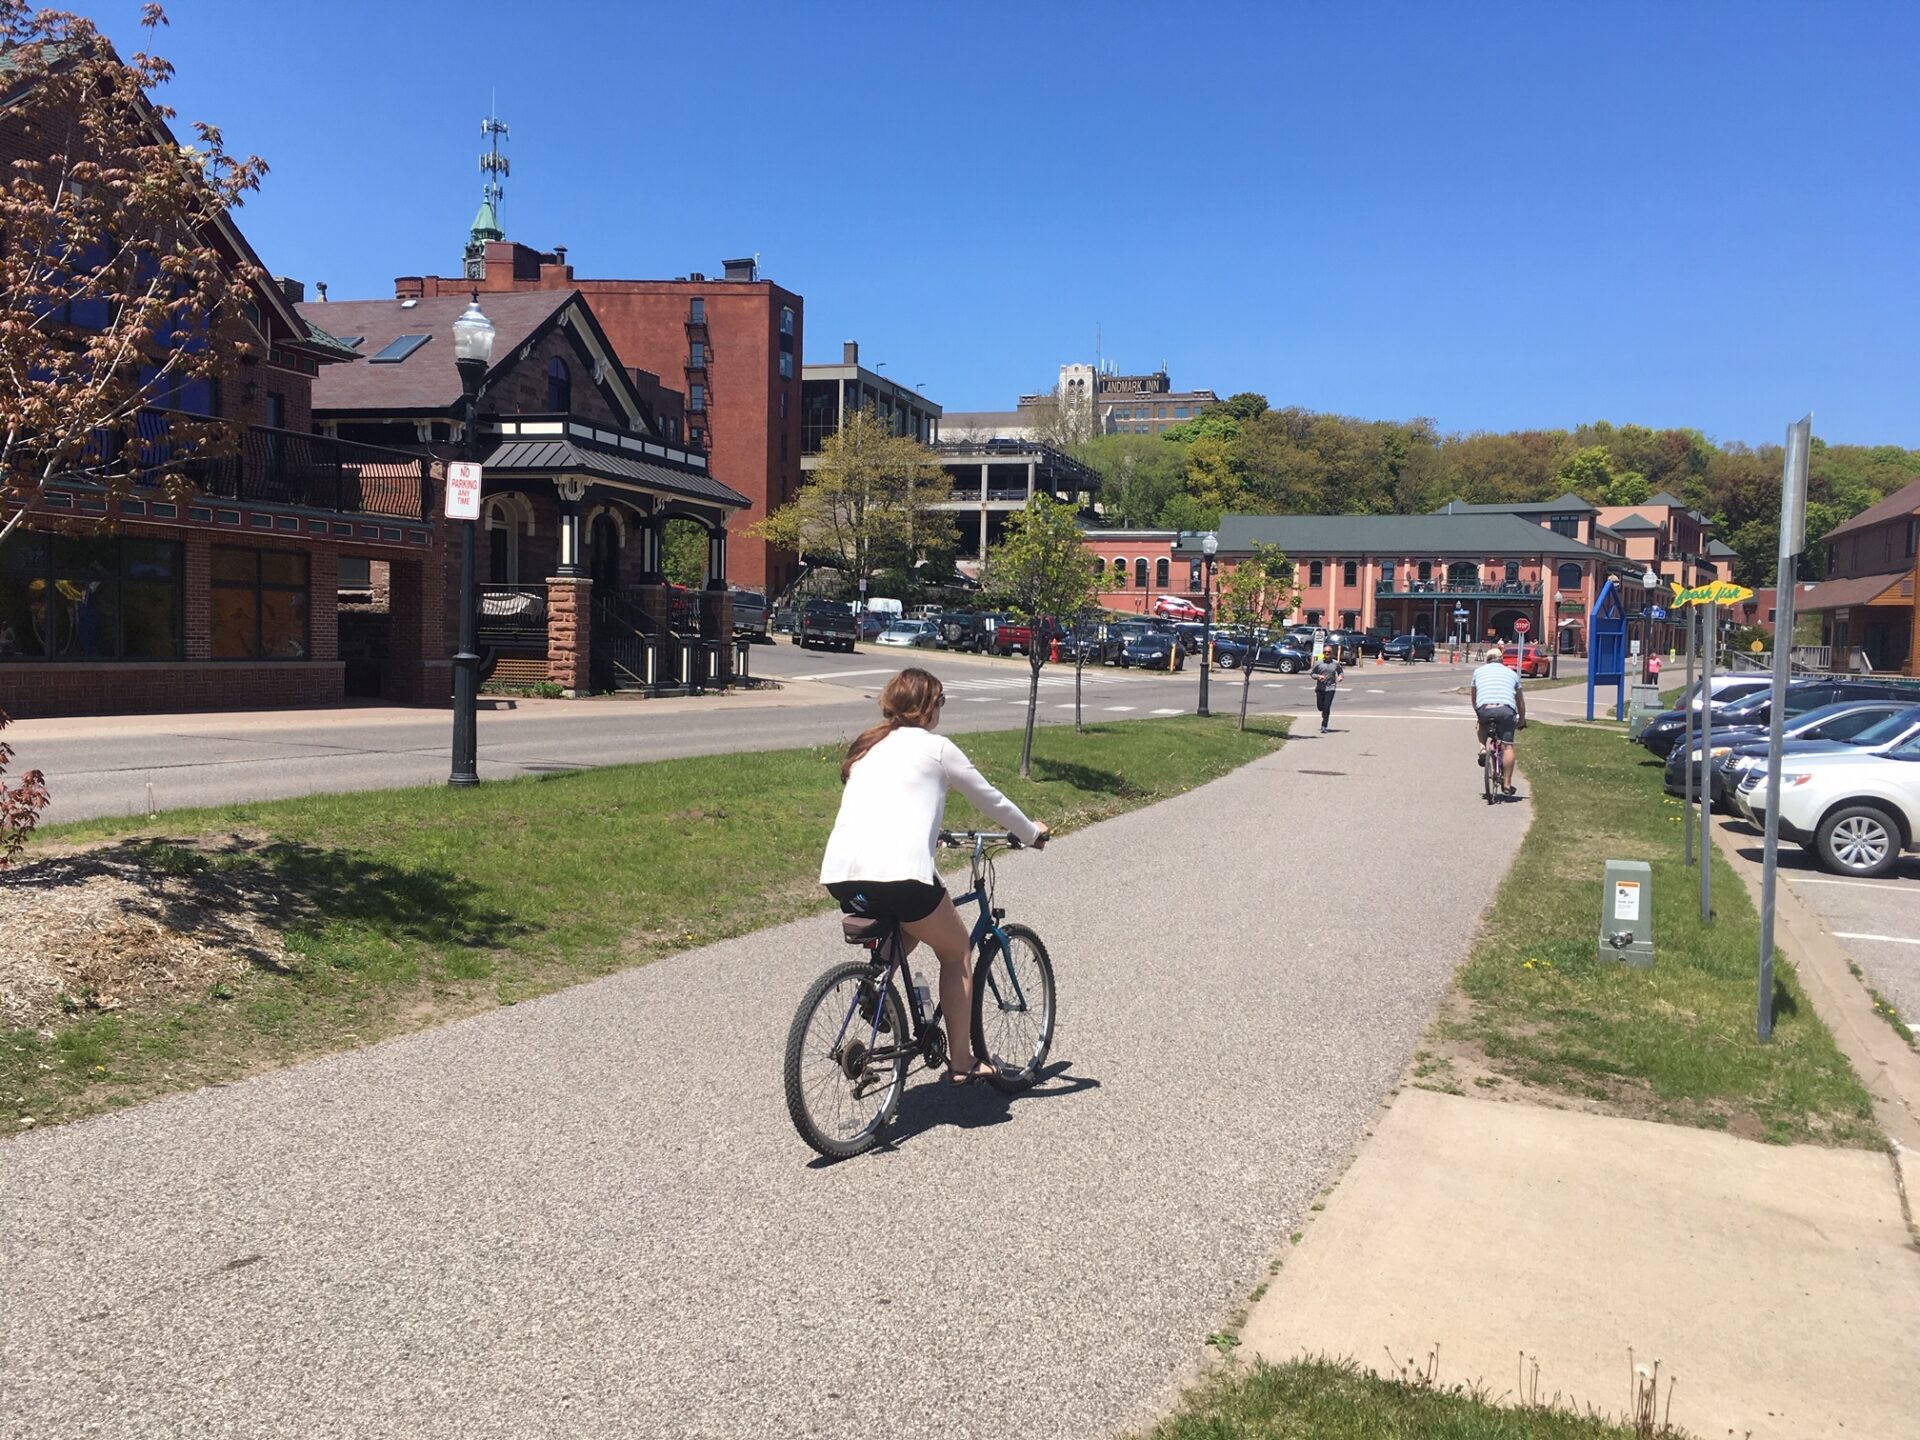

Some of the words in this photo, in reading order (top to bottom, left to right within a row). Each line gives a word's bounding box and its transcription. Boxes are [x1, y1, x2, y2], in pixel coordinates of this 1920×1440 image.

[1102, 380, 1142, 393] LANDMARK
[1145, 379, 1159, 392] INN
[460, 466, 470, 478] NO
[451, 478, 477, 490] PARKING
[457, 497, 470, 505] TIME
